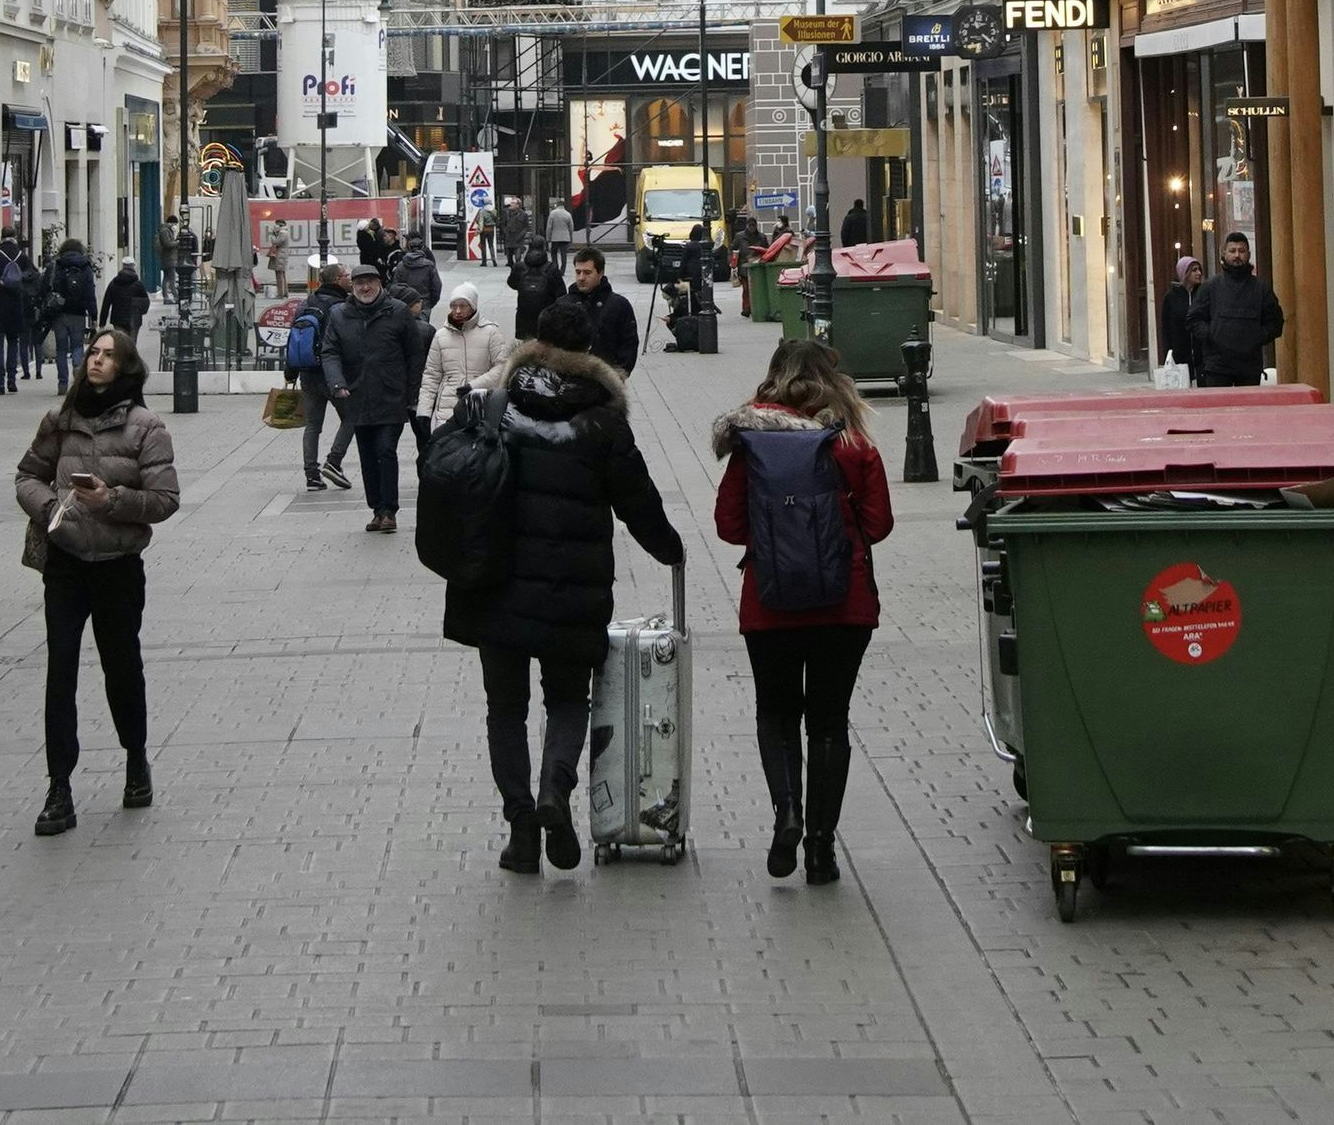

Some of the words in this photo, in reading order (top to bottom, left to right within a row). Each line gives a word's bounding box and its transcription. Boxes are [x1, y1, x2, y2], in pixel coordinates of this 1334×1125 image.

[1006, 0, 1094, 28] FENDI
[793, 20, 825, 28] Museum
[827, 20, 839, 28] der
[798, 30, 836, 39] Illusionen
[836, 51, 884, 63] GIORGIO
[1227, 106, 1285, 116] SCHULLIN
